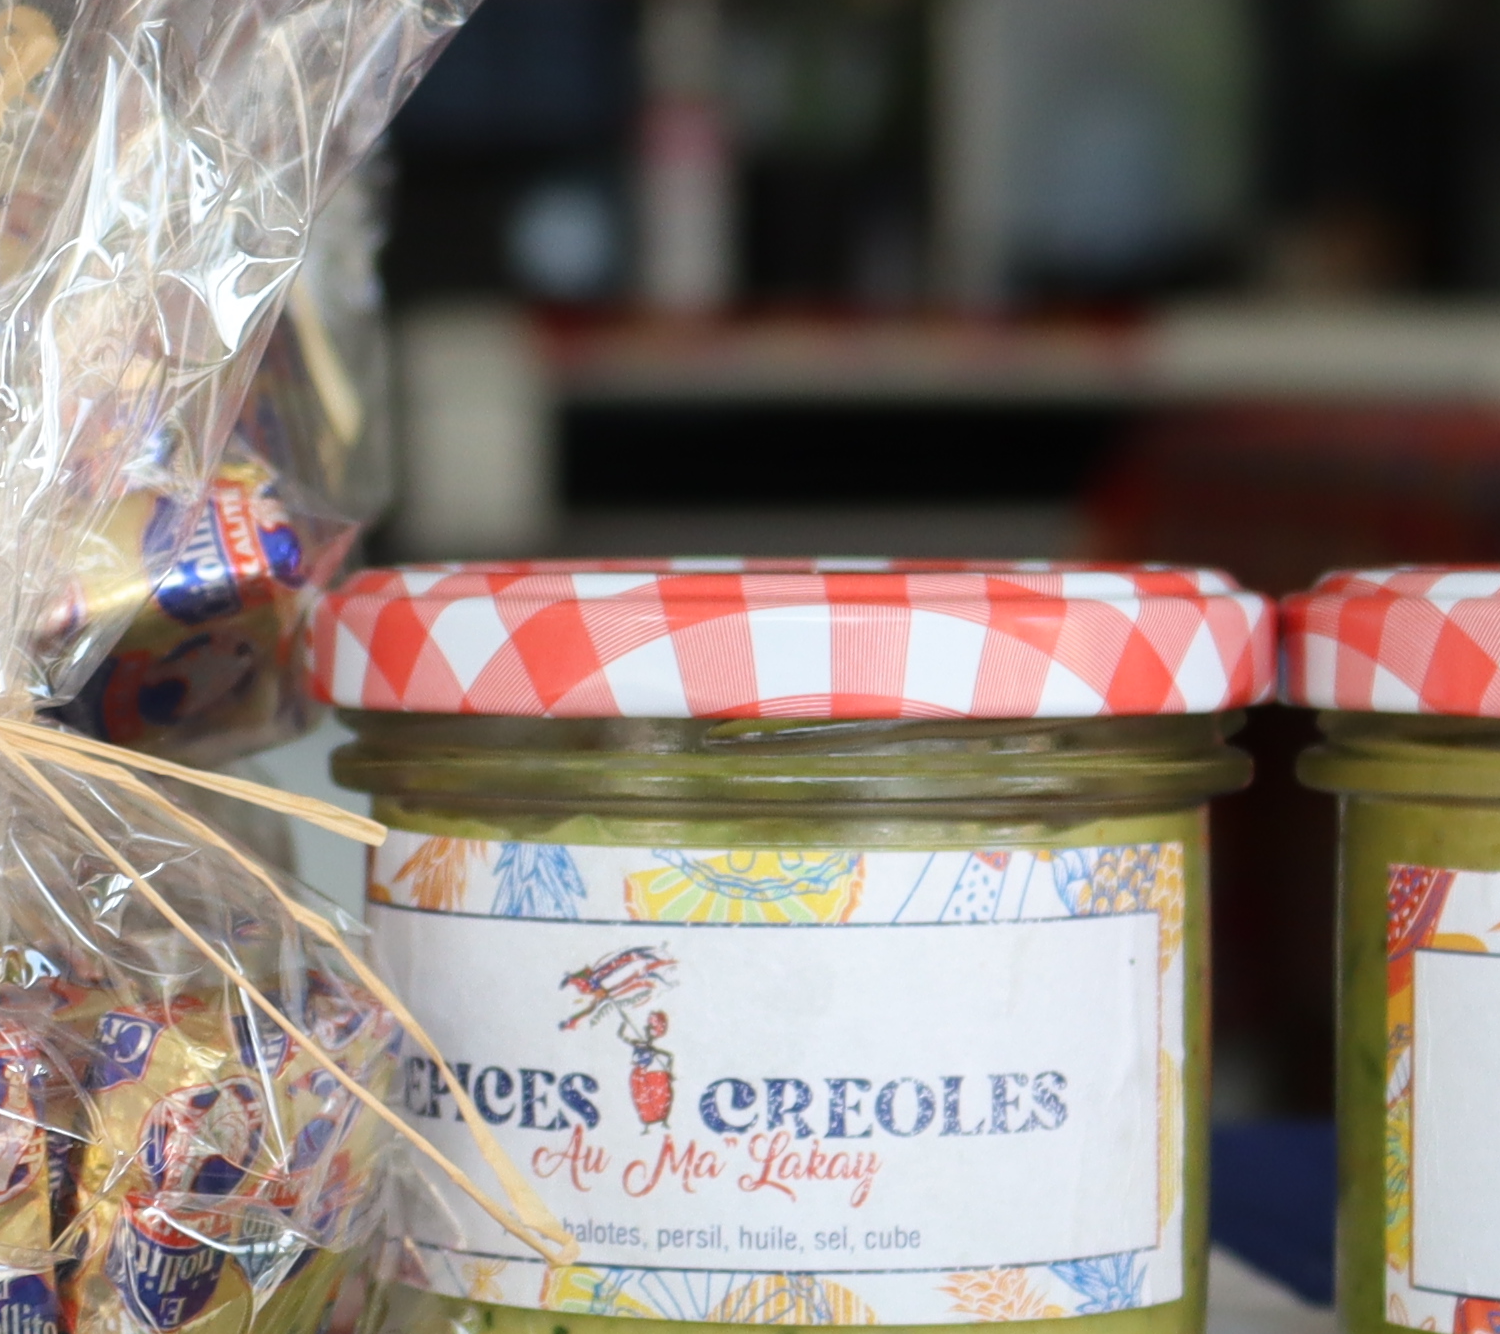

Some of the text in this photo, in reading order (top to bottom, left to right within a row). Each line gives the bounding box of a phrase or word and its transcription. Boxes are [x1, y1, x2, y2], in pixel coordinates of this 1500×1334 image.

[698, 1070, 1069, 1140] CREOLES
[531, 1123, 611, 1194] Au
[738, 1130, 885, 1209] Lakay
[656, 1223, 730, 1253] persil,
[738, 1224, 805, 1254] huile,
[813, 1224, 856, 1254] sel,
[864, 1224, 922, 1250] cube
